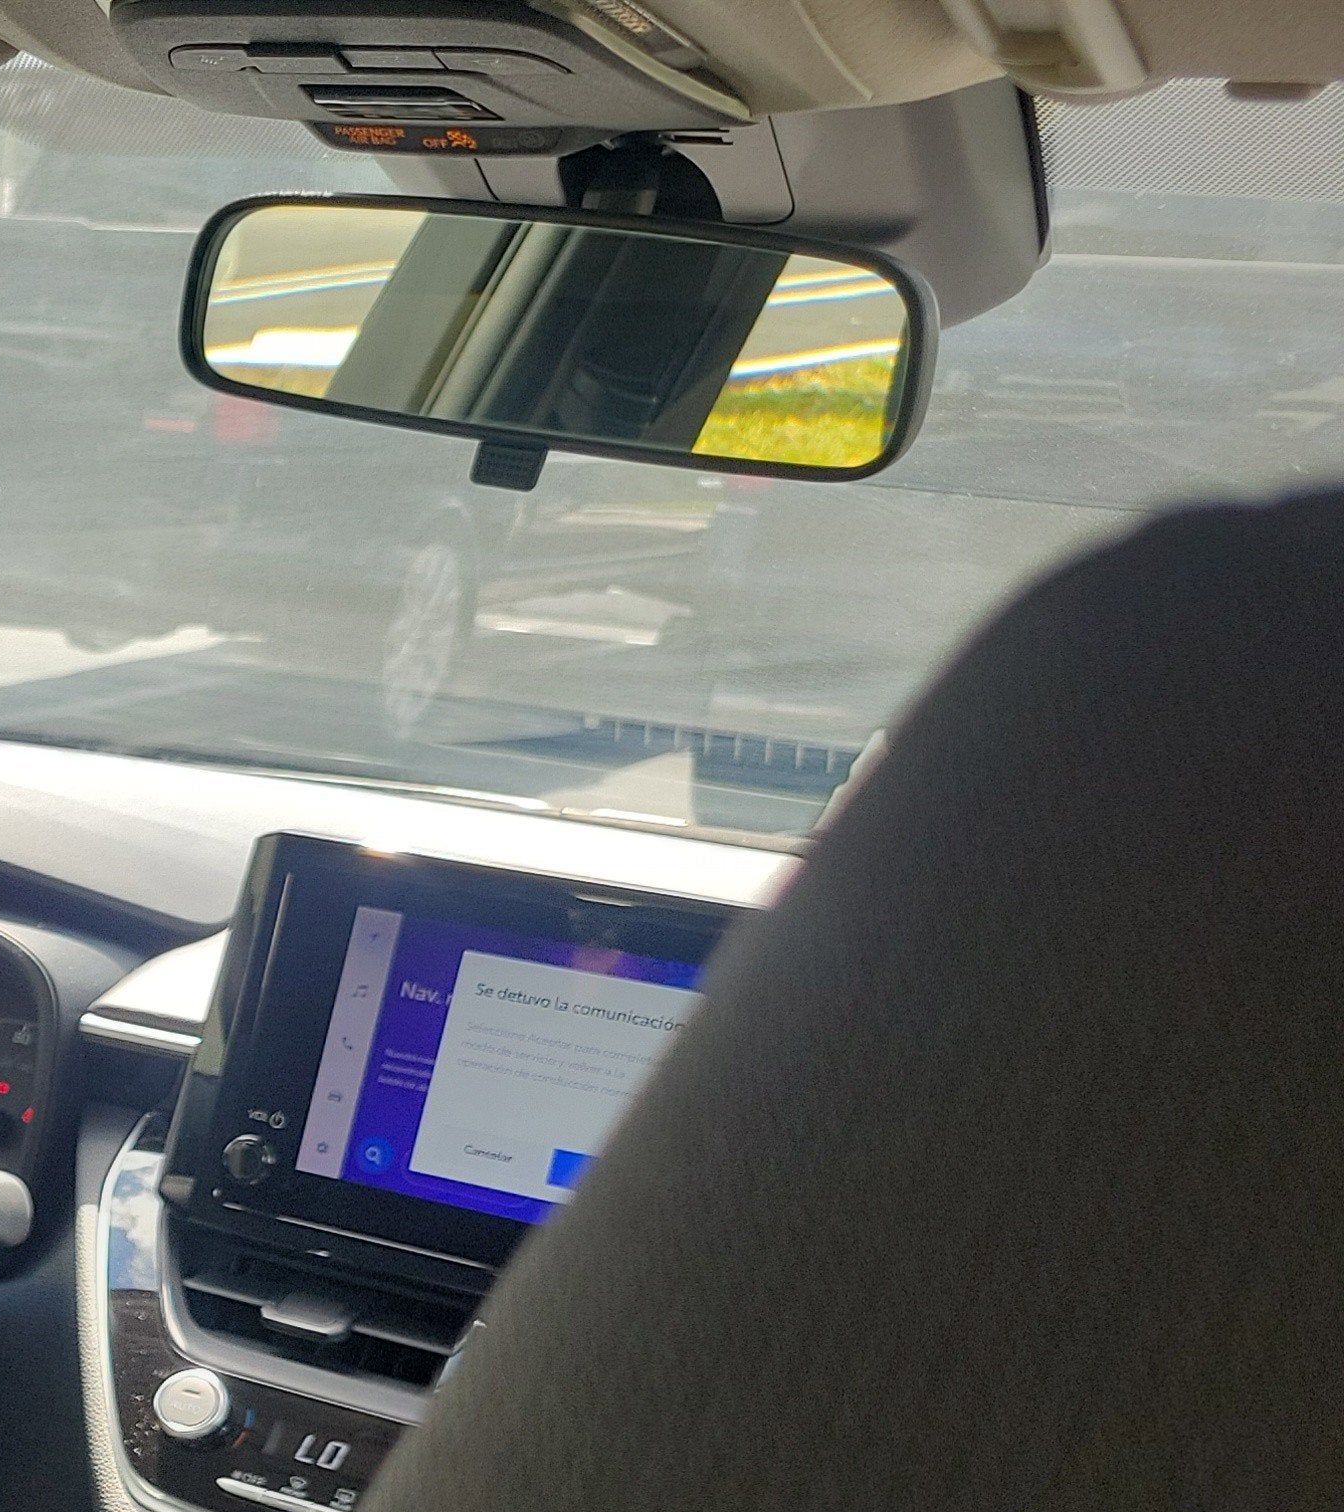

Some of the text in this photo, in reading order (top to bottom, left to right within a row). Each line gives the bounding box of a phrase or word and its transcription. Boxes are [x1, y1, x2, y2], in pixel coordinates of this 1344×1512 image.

[334, 126, 406, 138] PASSENGER
[422, 137, 448, 149] OFF
[401, 981, 440, 1005] Nav.
[474, 982, 494, 998] Se
[496, 988, 551, 1009] detuvo
[554, 996, 569, 1012] la
[294, 1434, 352, 1472] LO
